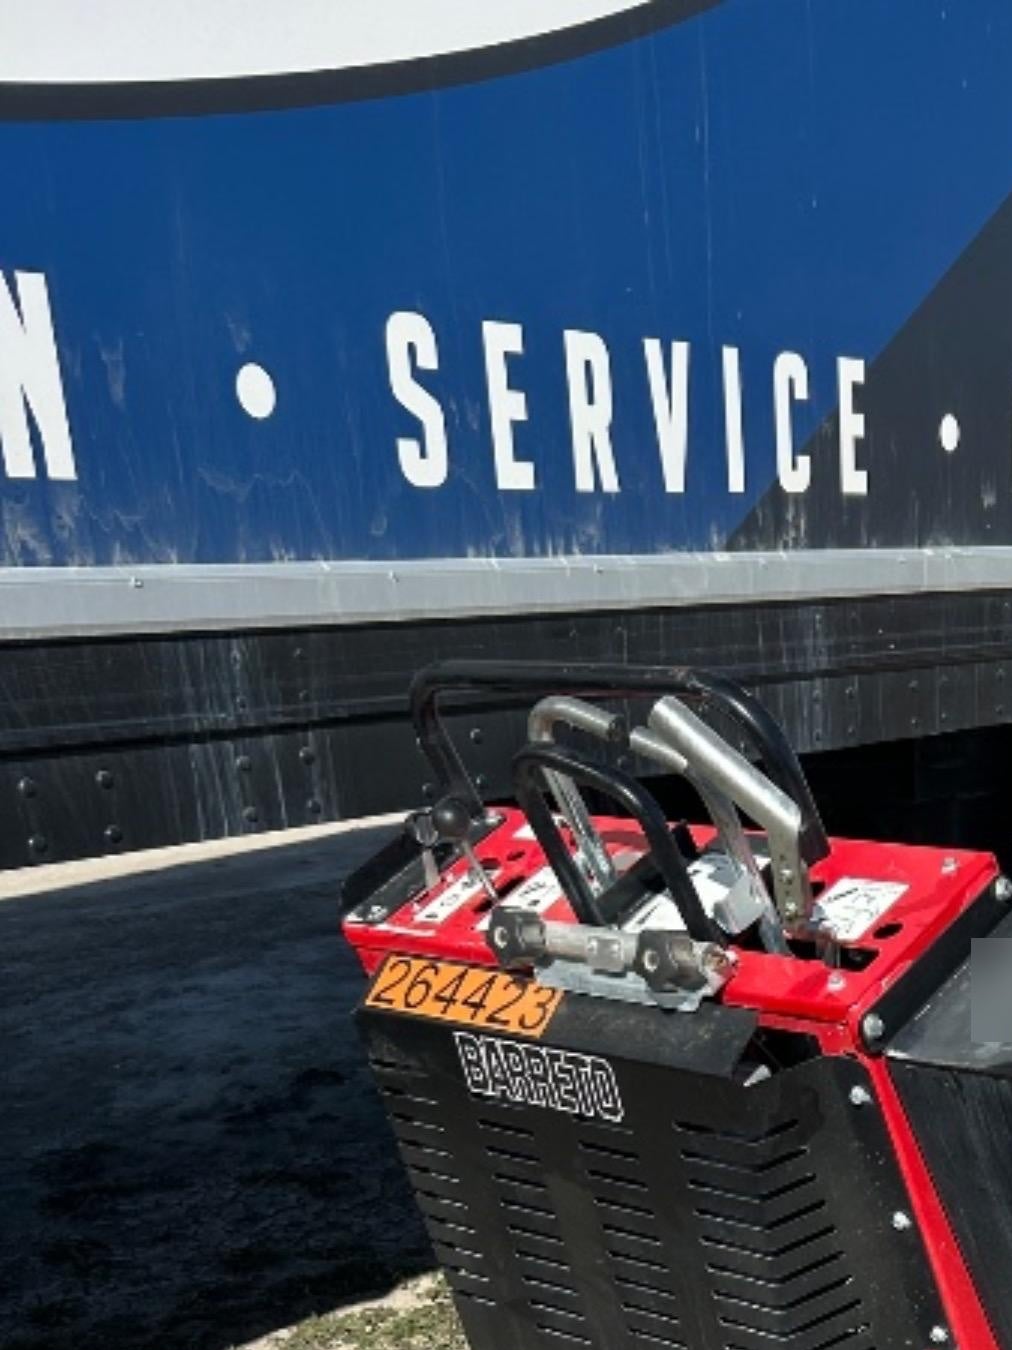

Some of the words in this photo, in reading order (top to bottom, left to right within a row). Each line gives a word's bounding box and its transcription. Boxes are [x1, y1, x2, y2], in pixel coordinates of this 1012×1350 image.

[385, 310, 870, 495] SERVICE
[370, 959, 557, 1032] 264423
[452, 1031, 625, 1123] BARRETO
